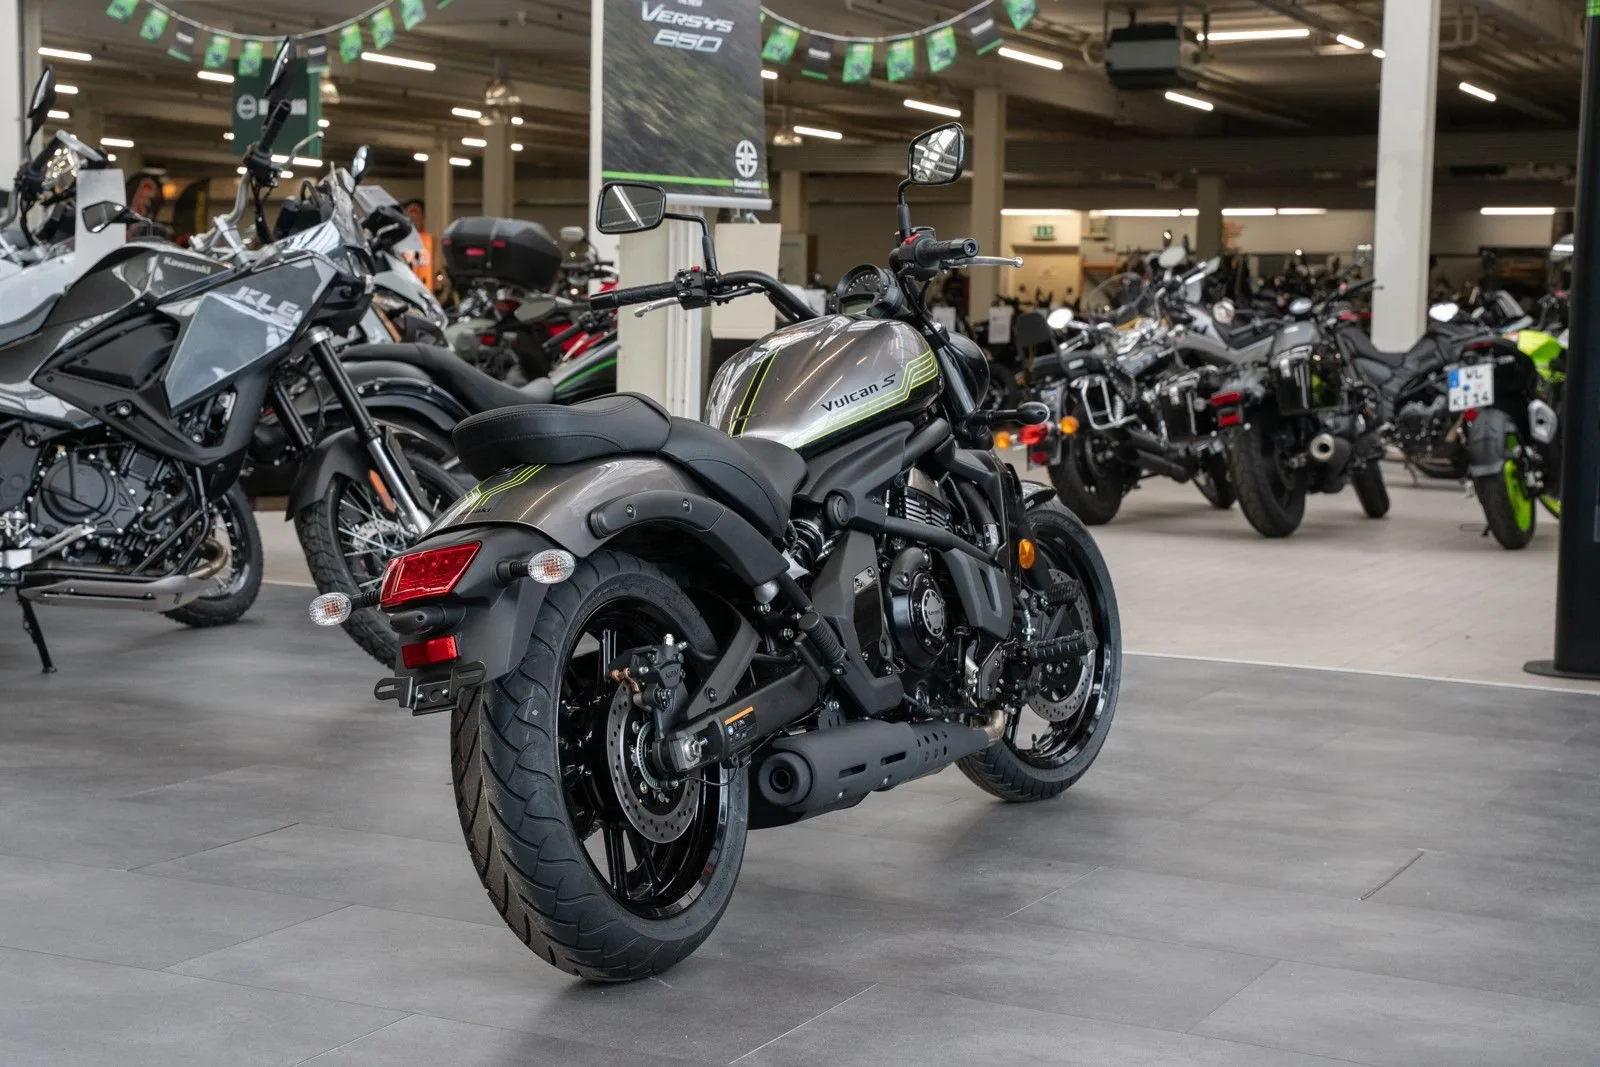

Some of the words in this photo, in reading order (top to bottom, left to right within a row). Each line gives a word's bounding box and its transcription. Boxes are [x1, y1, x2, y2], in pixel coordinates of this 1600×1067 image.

[641, 0, 735, 33] VERSYS
[653, 28, 723, 53] 650
[163, 256, 212, 275] Kawasaki
[821, 383, 879, 412] Vulcan
[881, 373, 897, 389] S
